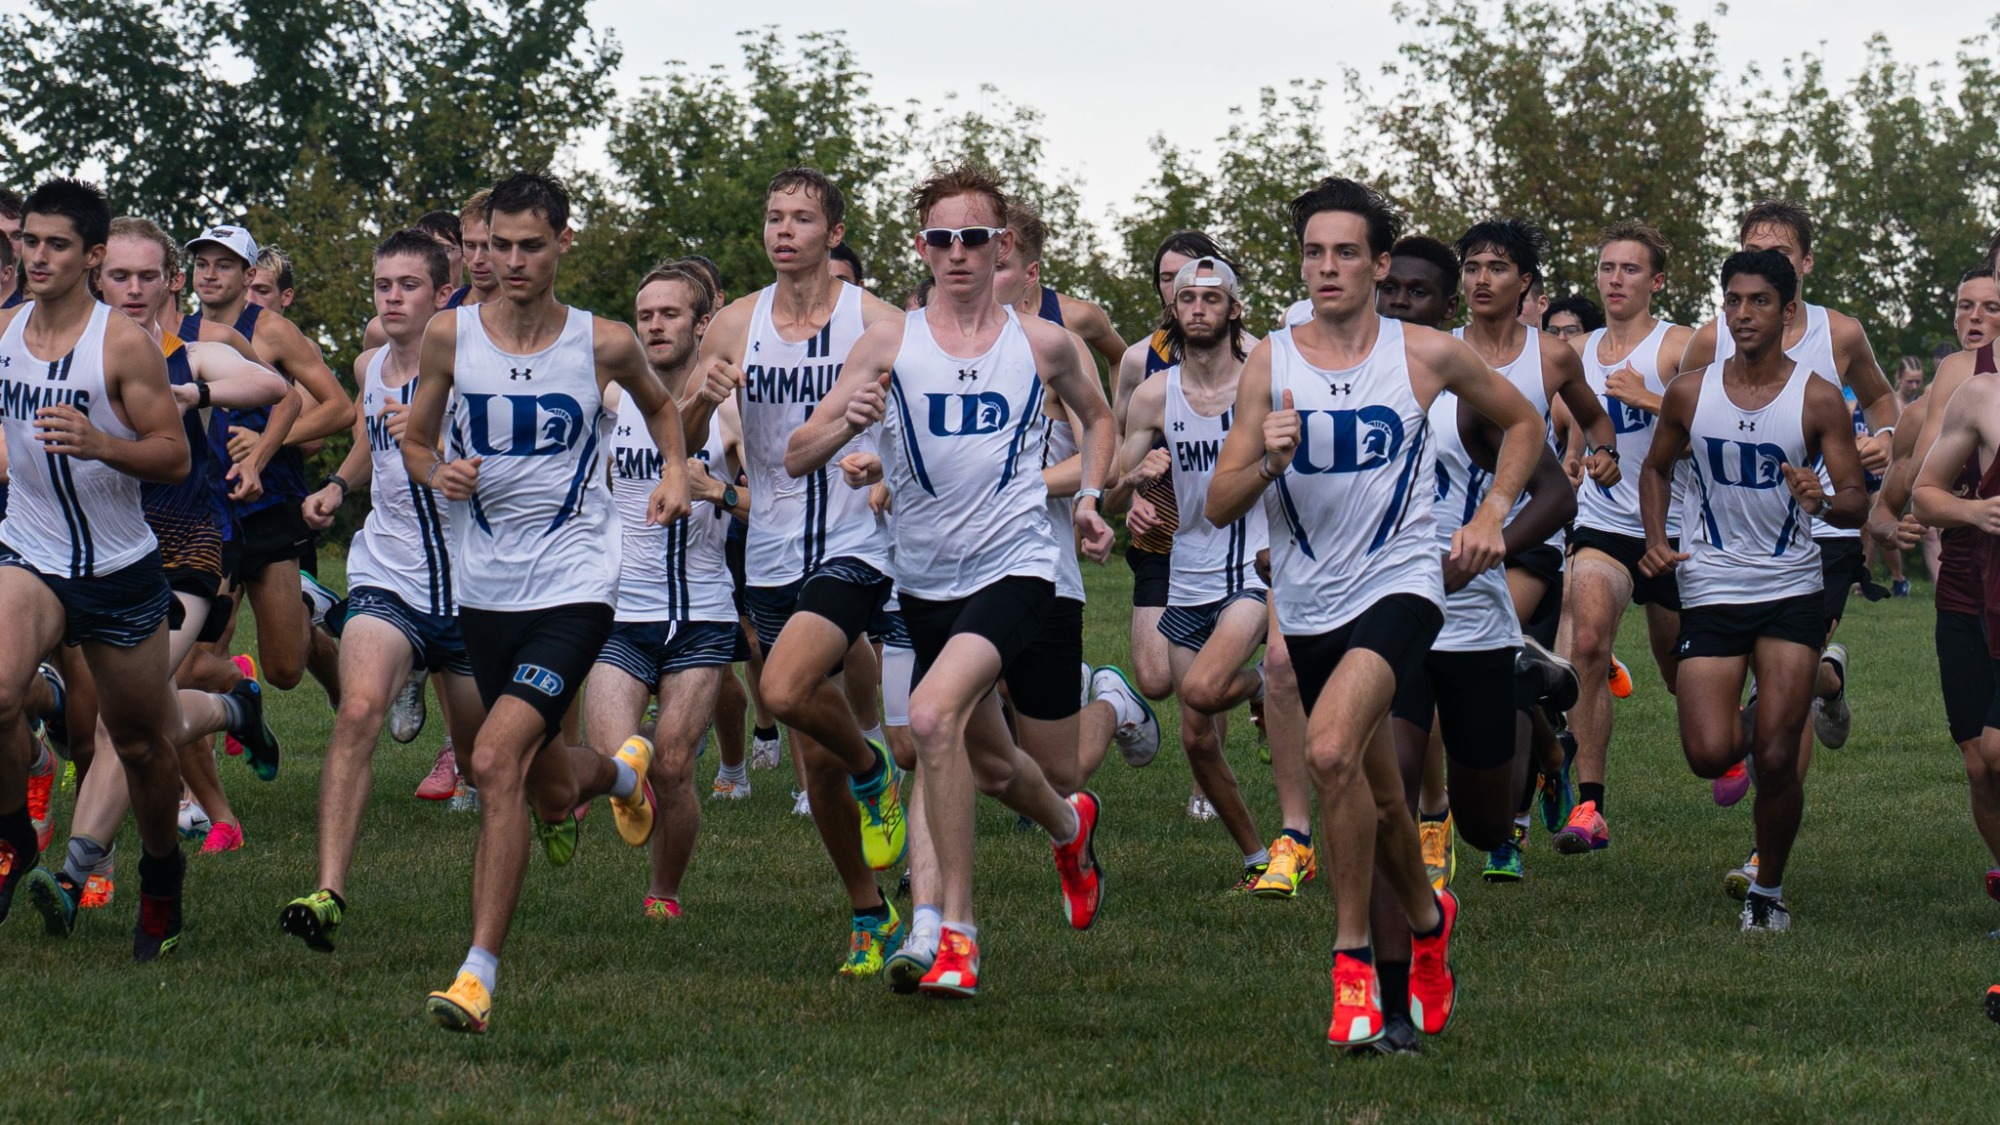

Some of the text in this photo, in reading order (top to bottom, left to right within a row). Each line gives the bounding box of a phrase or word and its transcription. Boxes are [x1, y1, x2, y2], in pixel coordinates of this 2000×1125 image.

[461, 392, 584, 456] UD
[923, 391, 1010, 437] UD
[1176, 439, 1224, 472] EMM
[1701, 436, 1788, 489] UD
[513, 663, 564, 696] UD
